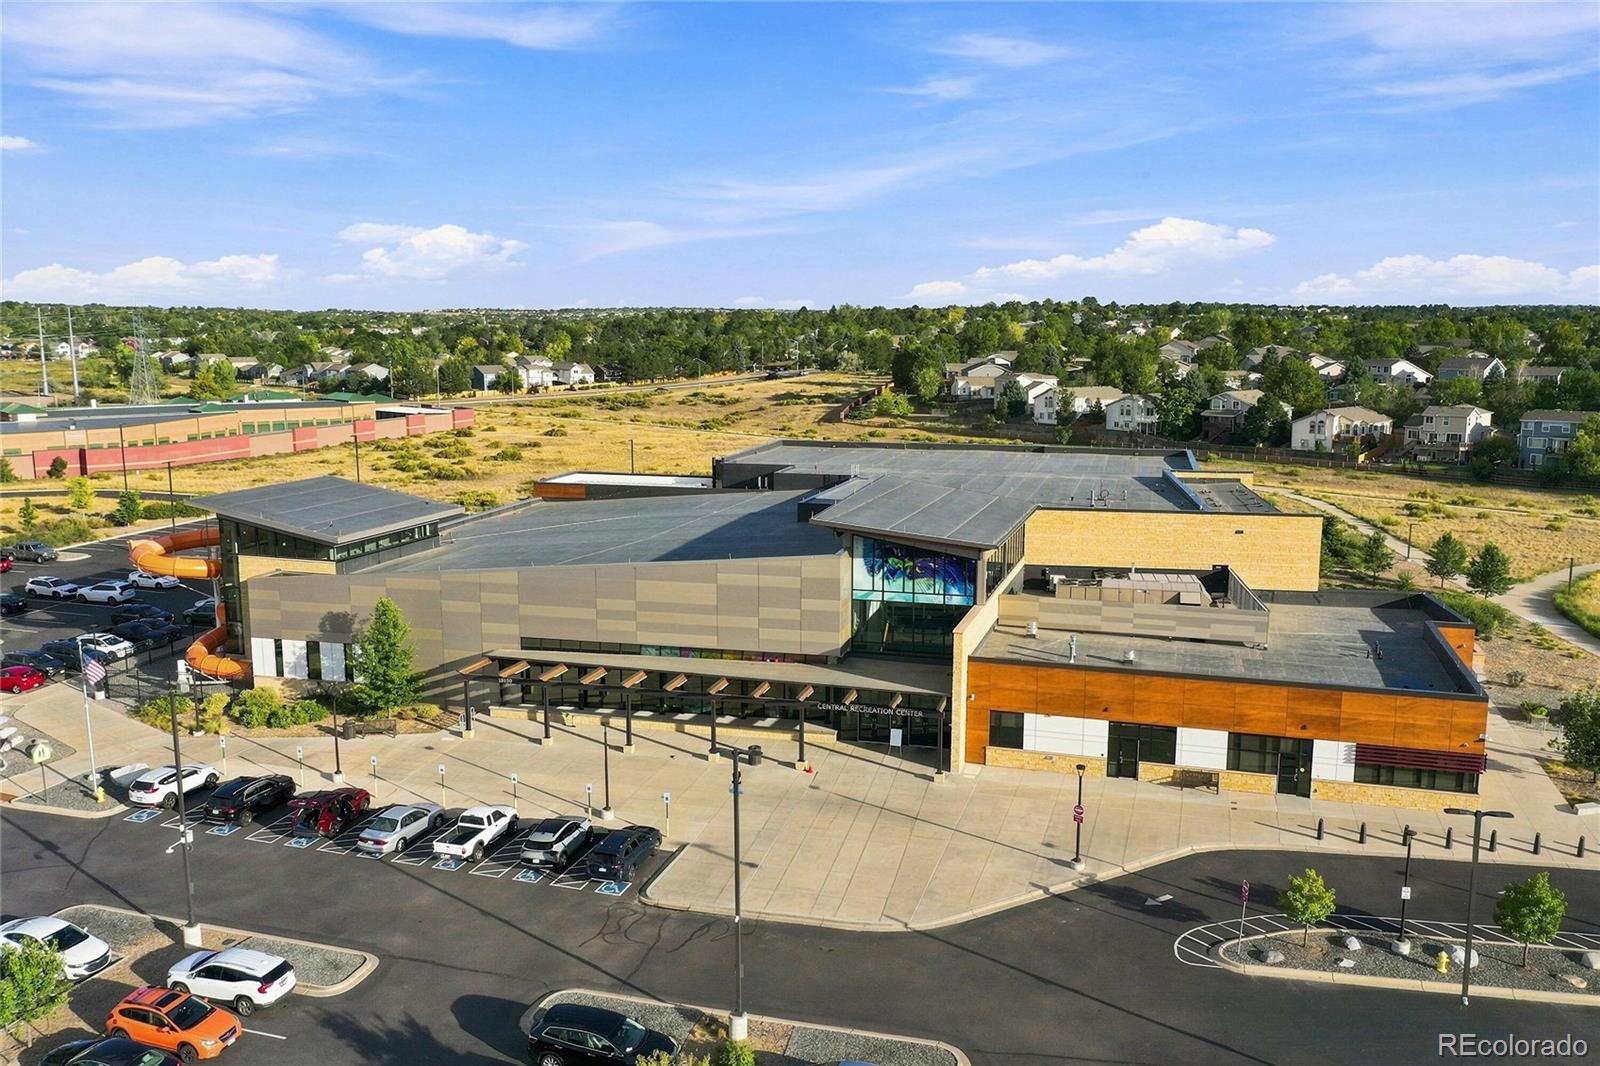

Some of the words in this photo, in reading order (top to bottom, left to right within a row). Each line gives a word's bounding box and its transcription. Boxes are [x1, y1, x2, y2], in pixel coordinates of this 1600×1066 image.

[817, 703, 848, 712] CENTRAL
[850, 704, 894, 715] RECREATION
[895, 708, 924, 718] CENTER
